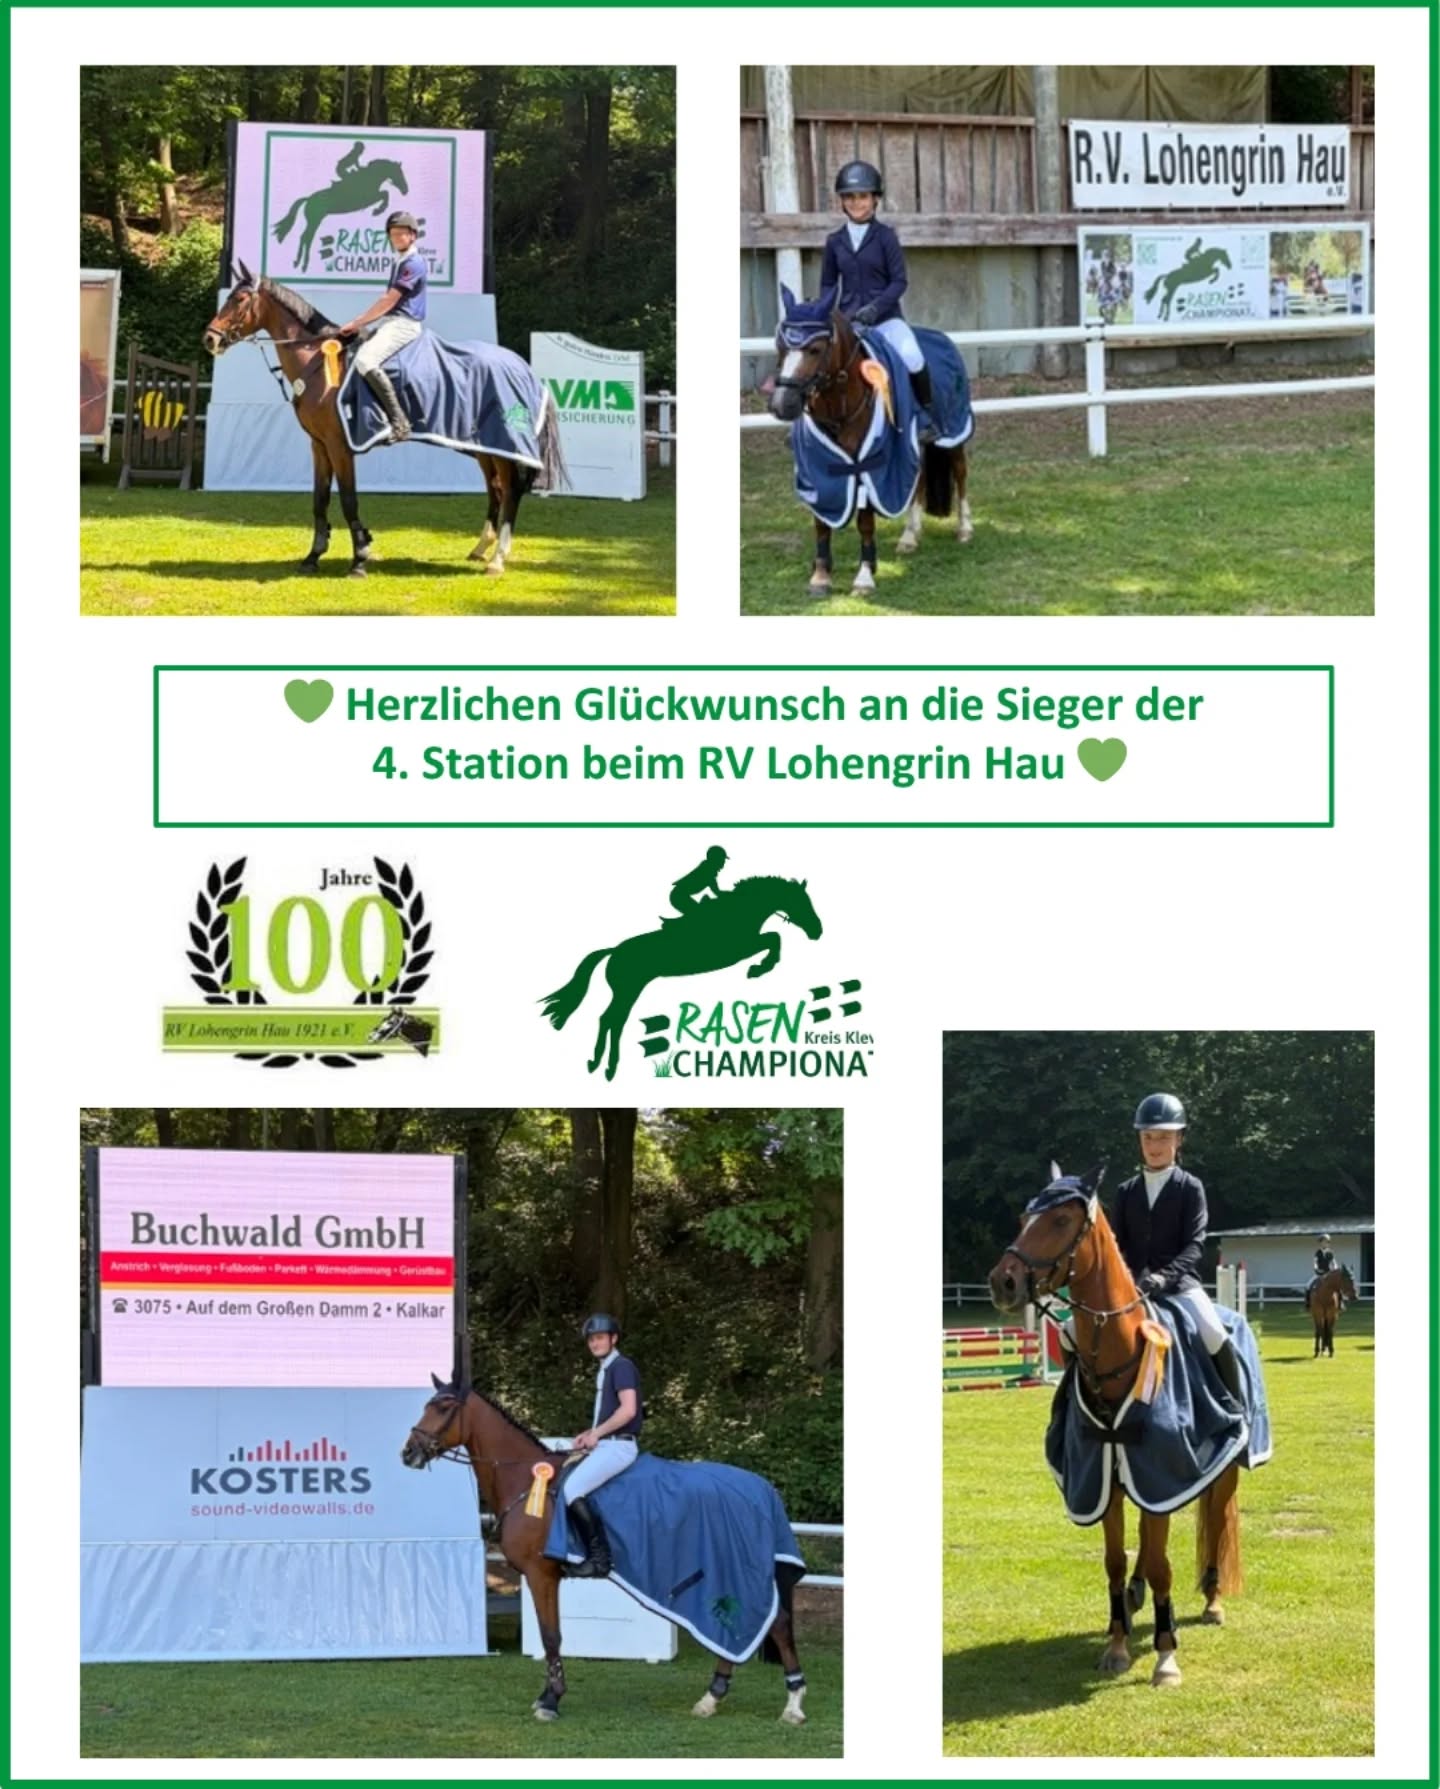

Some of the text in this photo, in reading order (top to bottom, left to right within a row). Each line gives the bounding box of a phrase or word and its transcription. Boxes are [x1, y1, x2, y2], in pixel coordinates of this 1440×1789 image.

[1075, 130, 1346, 197] R.V. Lohengrin Hau
[1326, 187, 1346, 198] e.V.
[541, 378, 601, 409] VM
[131, 1212, 424, 1249] Buchwald GmbH
[110, 1261, 150, 1272] Anstrich
[159, 1263, 212, 1275] Verglasung
[134, 1300, 445, 1319] 3075 Auf dem Großen Damm 2 Kalkar
[191, 1502, 375, 1517] sound-videowalls.de
